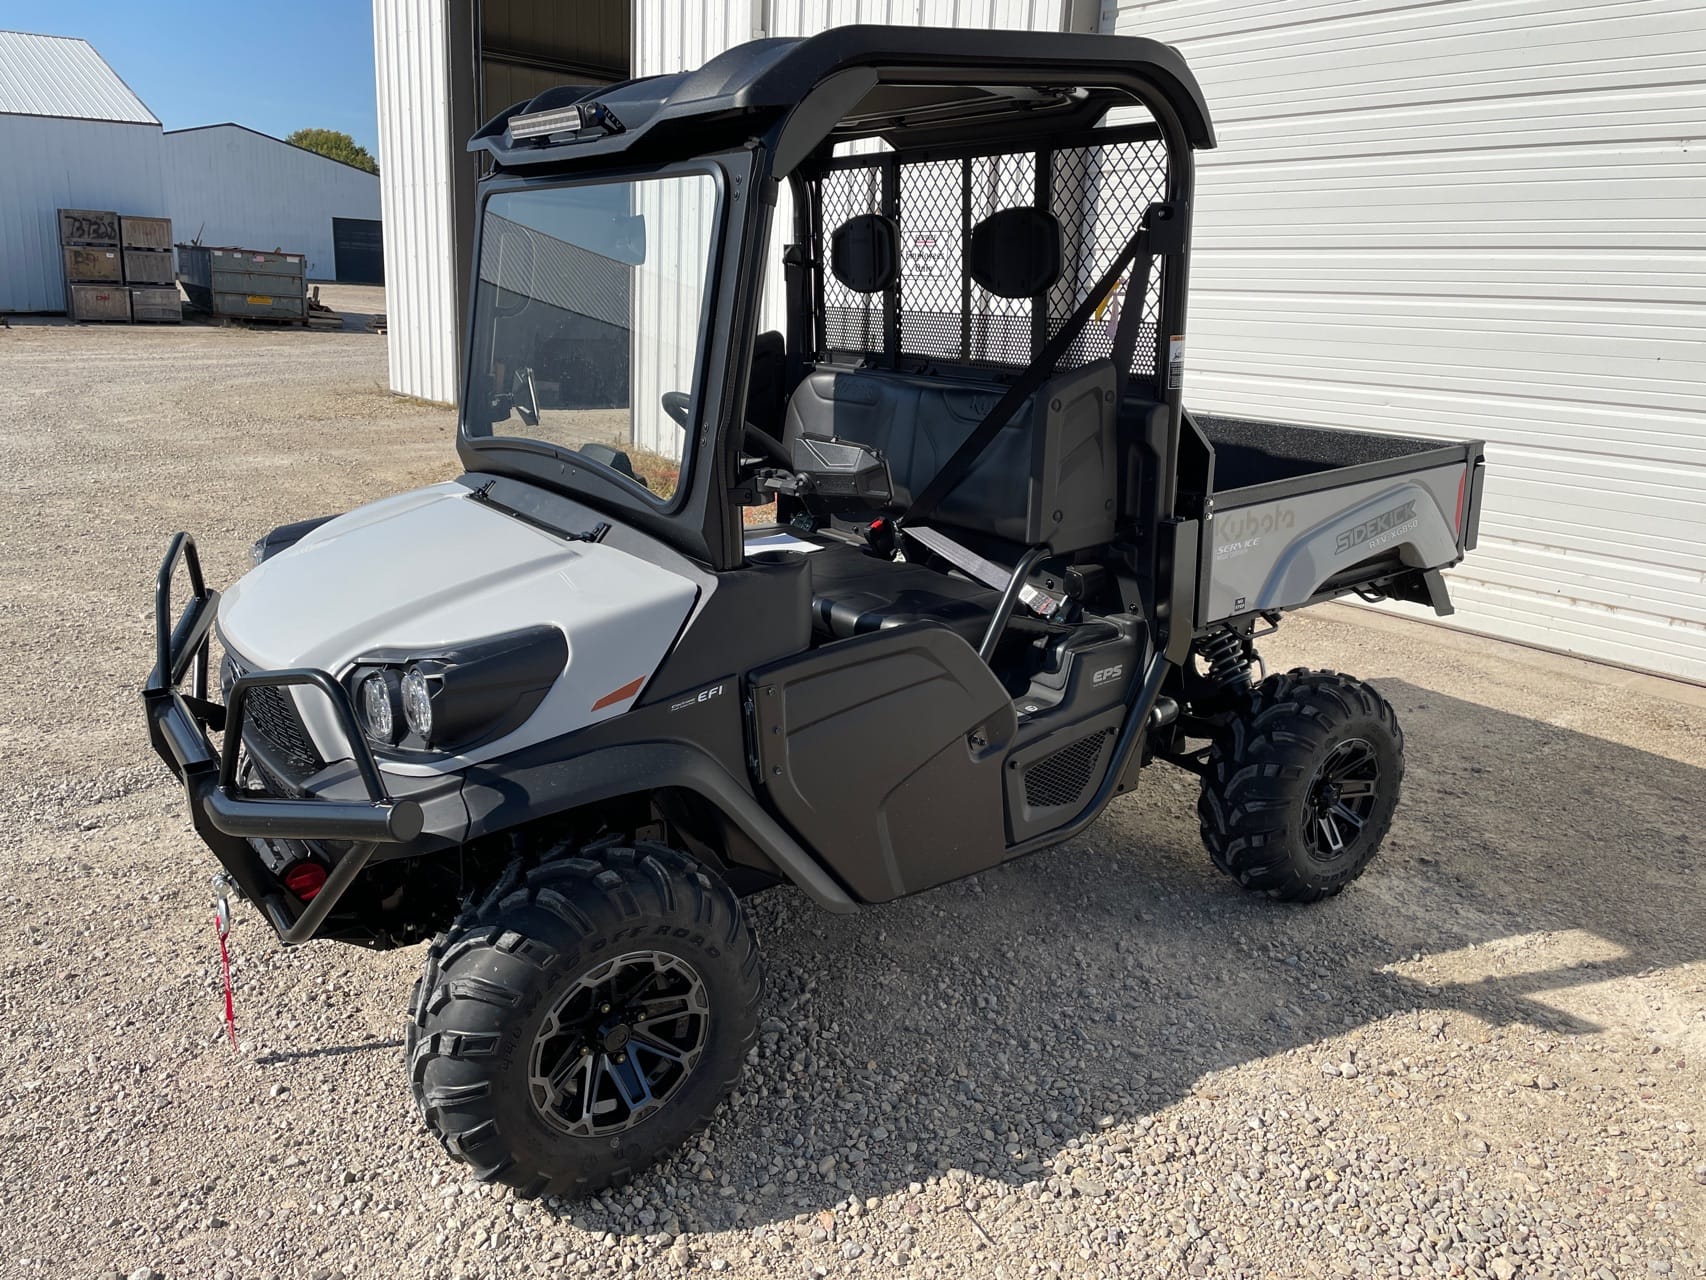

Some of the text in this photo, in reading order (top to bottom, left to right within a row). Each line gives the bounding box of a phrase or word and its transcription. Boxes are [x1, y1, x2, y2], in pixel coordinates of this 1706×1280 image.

[1214, 504, 1295, 541] Kubota
[1334, 499, 1416, 555] SIDEKICK
[1217, 537, 1262, 554] SERVICE
[1093, 664, 1123, 683] EPS
[698, 685, 723, 702] EFI
